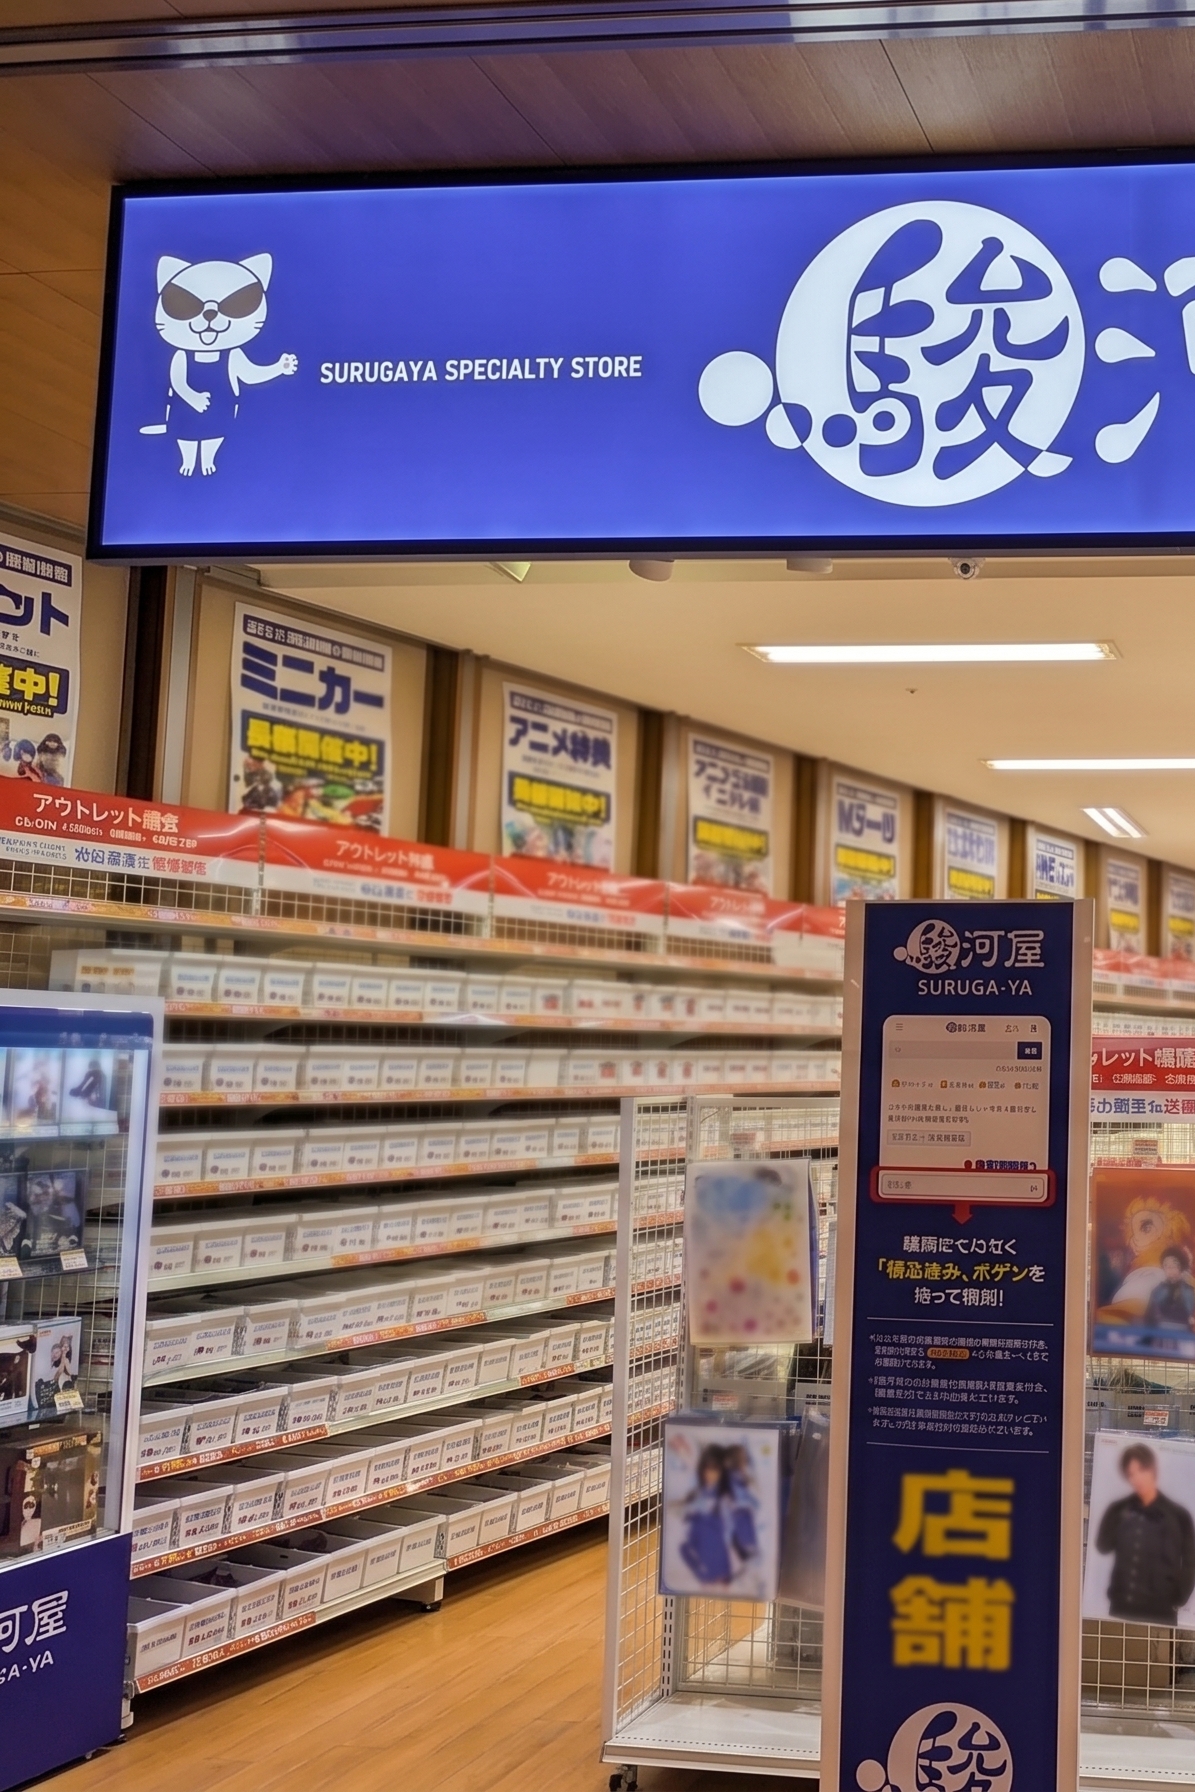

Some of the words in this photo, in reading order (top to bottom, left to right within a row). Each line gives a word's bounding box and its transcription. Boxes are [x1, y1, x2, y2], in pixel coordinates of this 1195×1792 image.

[320, 360, 438, 384] SURUGAYA
[444, 357, 565, 381] SPECIALTY
[570, 355, 643, 379] STORE
[240, 640, 385, 715] ミニカー
[893, 918, 1045, 975] 駿河屋
[917, 979, 1033, 996] SURUGA-YA
